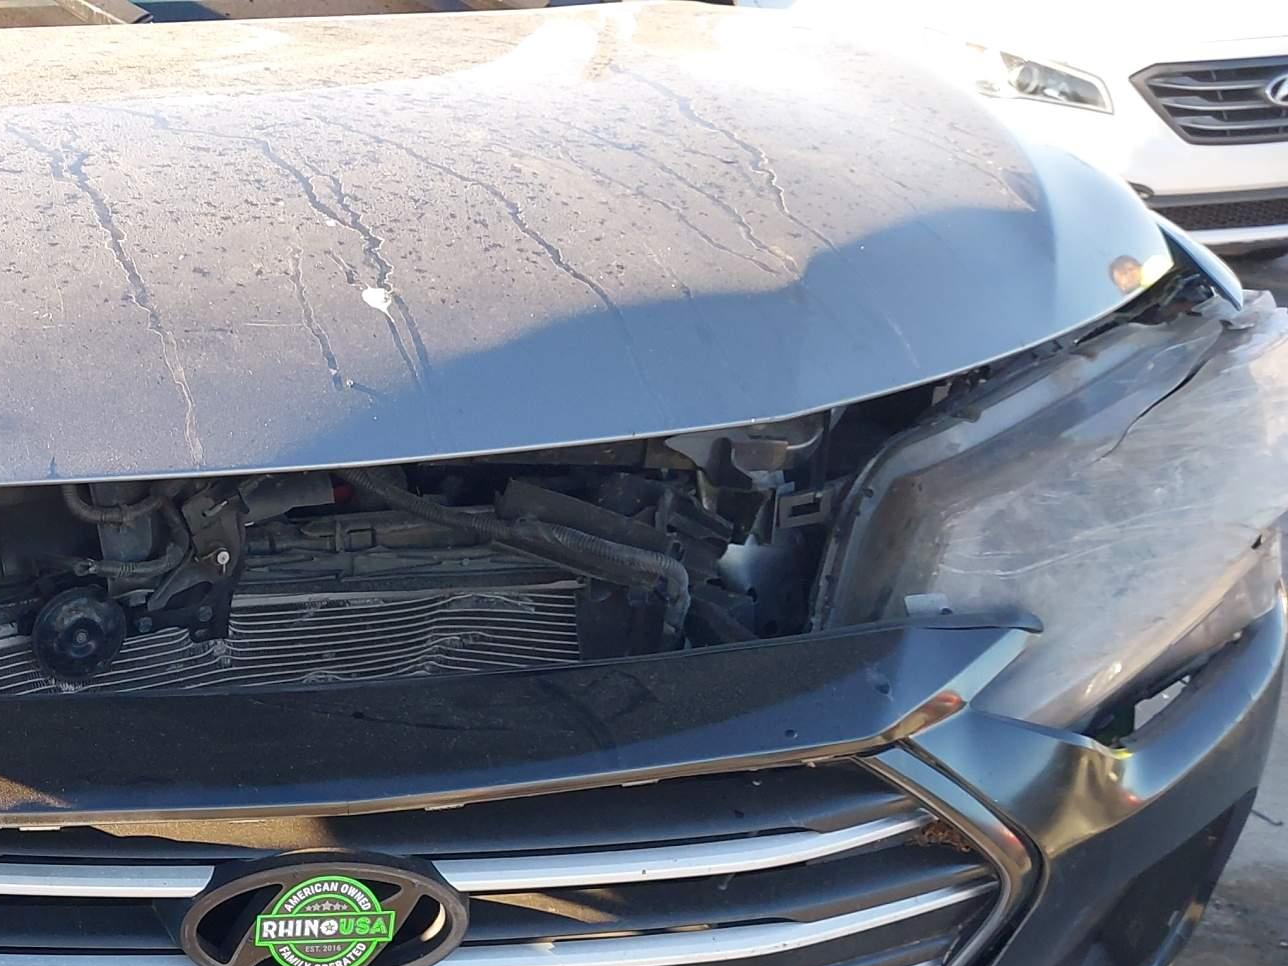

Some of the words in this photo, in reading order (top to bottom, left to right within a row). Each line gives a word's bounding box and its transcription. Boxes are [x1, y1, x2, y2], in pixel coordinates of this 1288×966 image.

[284, 882, 339, 913] AMERICAN
[340, 884, 371, 911] OWNED
[305, 945, 321, 953] EST.
[323, 944, 341, 953] 2016
